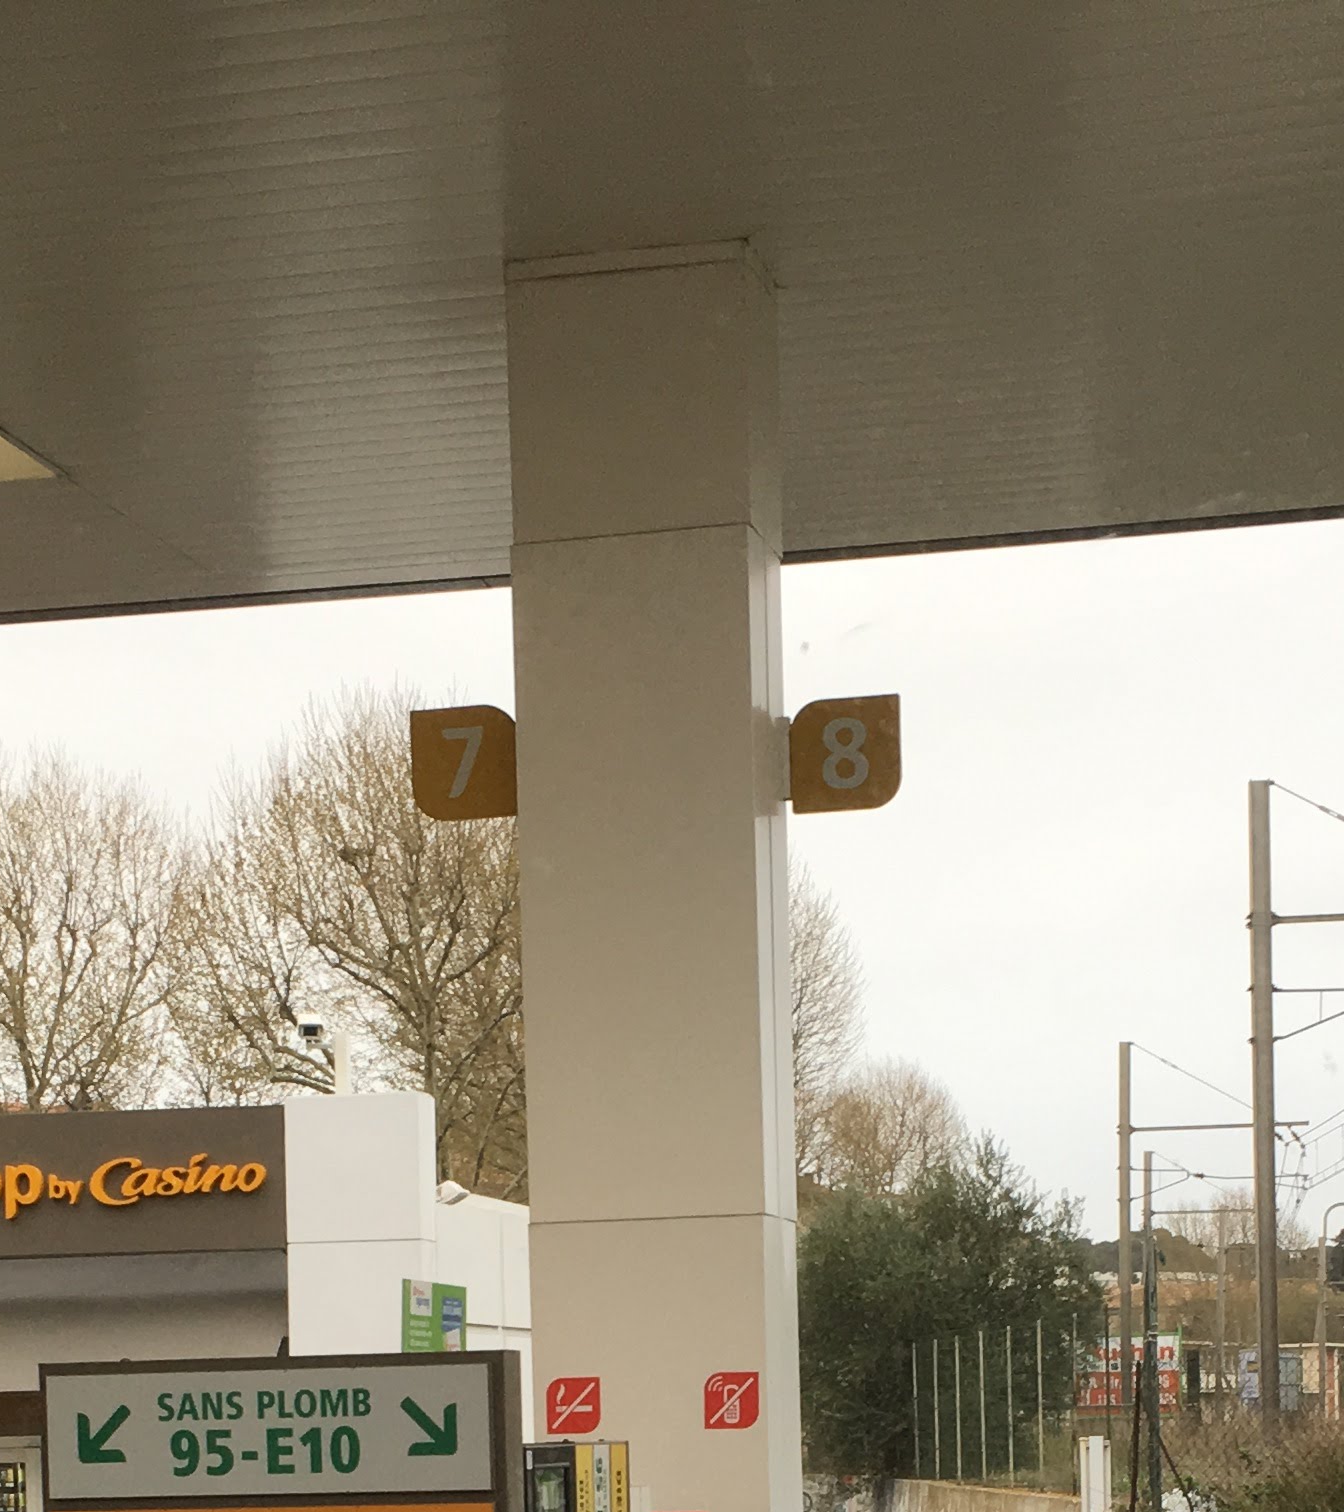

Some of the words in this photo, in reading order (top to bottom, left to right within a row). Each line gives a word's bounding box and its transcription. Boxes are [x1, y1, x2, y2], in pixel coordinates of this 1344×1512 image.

[441, 725, 484, 799] 7
[821, 717, 870, 790] 8
[48, 1174, 84, 1204] by
[89, 1153, 267, 1206] Casino
[157, 1390, 245, 1422] SANS
[256, 1388, 372, 1420] PLOMB
[169, 1425, 361, 1477] 95-E10
